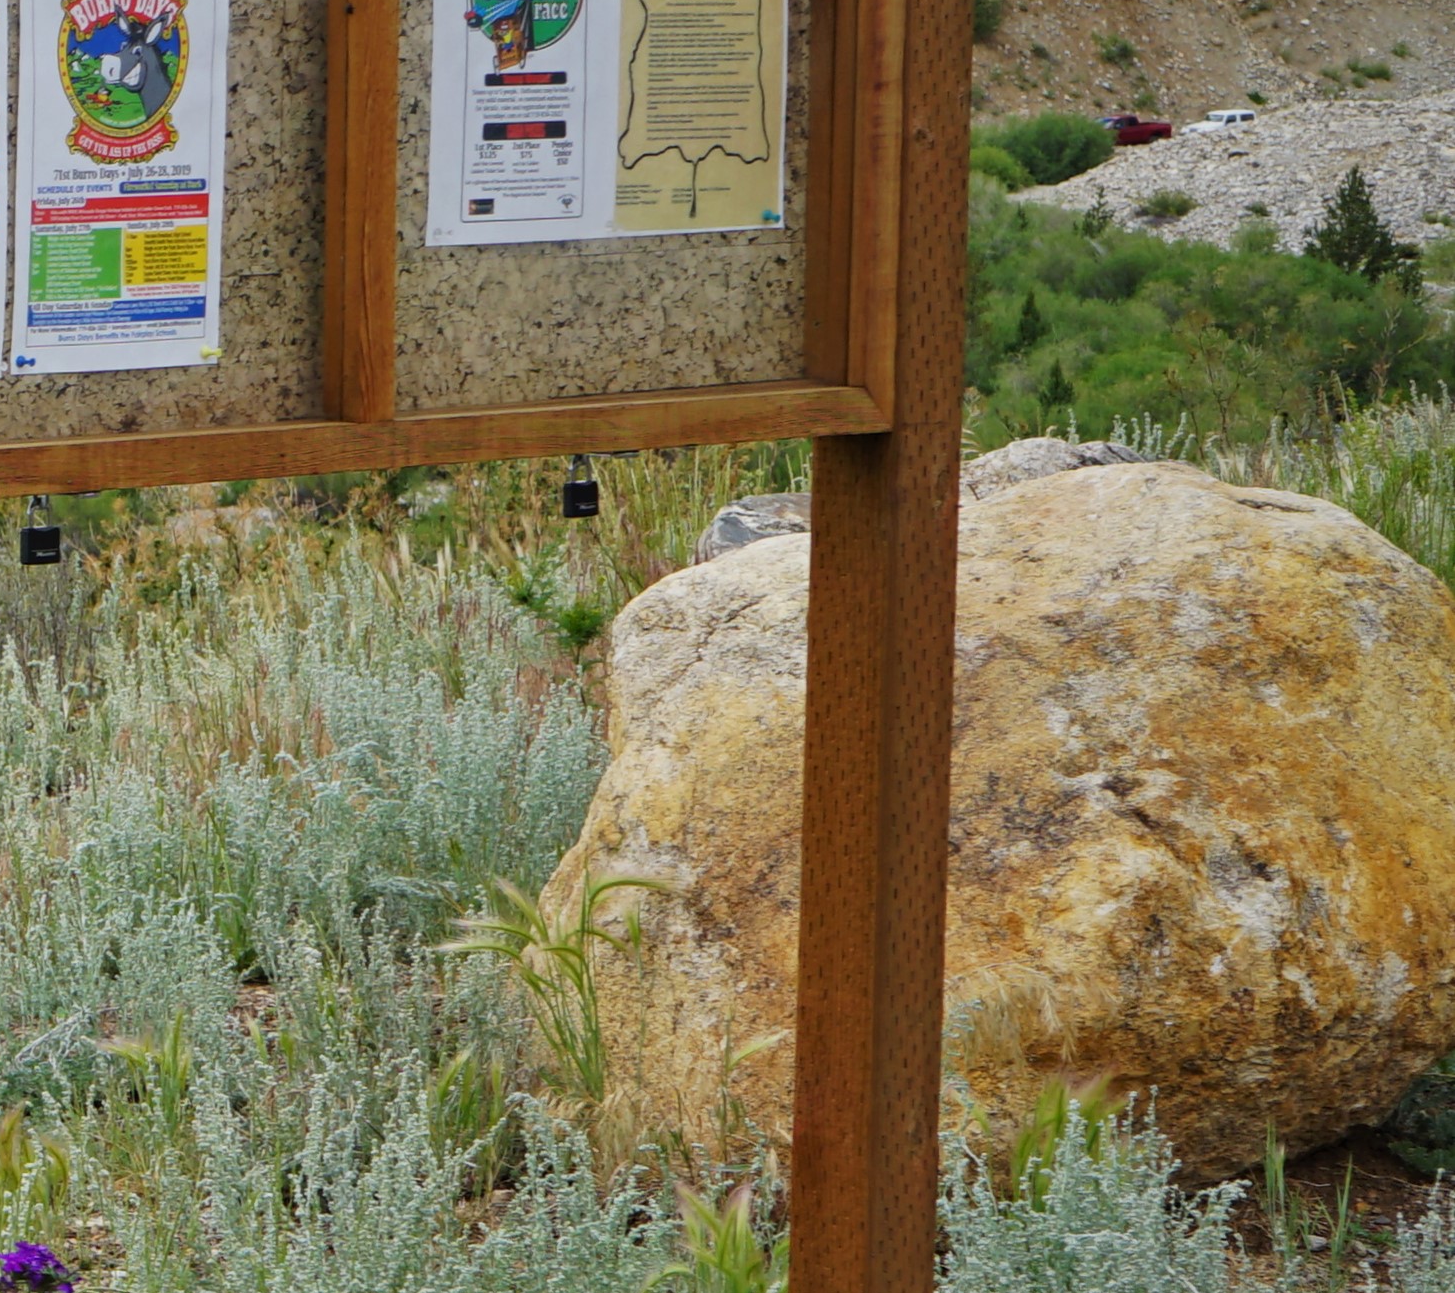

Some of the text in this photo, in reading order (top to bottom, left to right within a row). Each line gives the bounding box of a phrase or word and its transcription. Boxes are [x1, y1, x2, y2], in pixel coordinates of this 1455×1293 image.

[533, 2, 568, 20] race
[72, 168, 98, 179] Burro
[100, 167, 119, 181] Days
[171, 165, 191, 176] 2019
